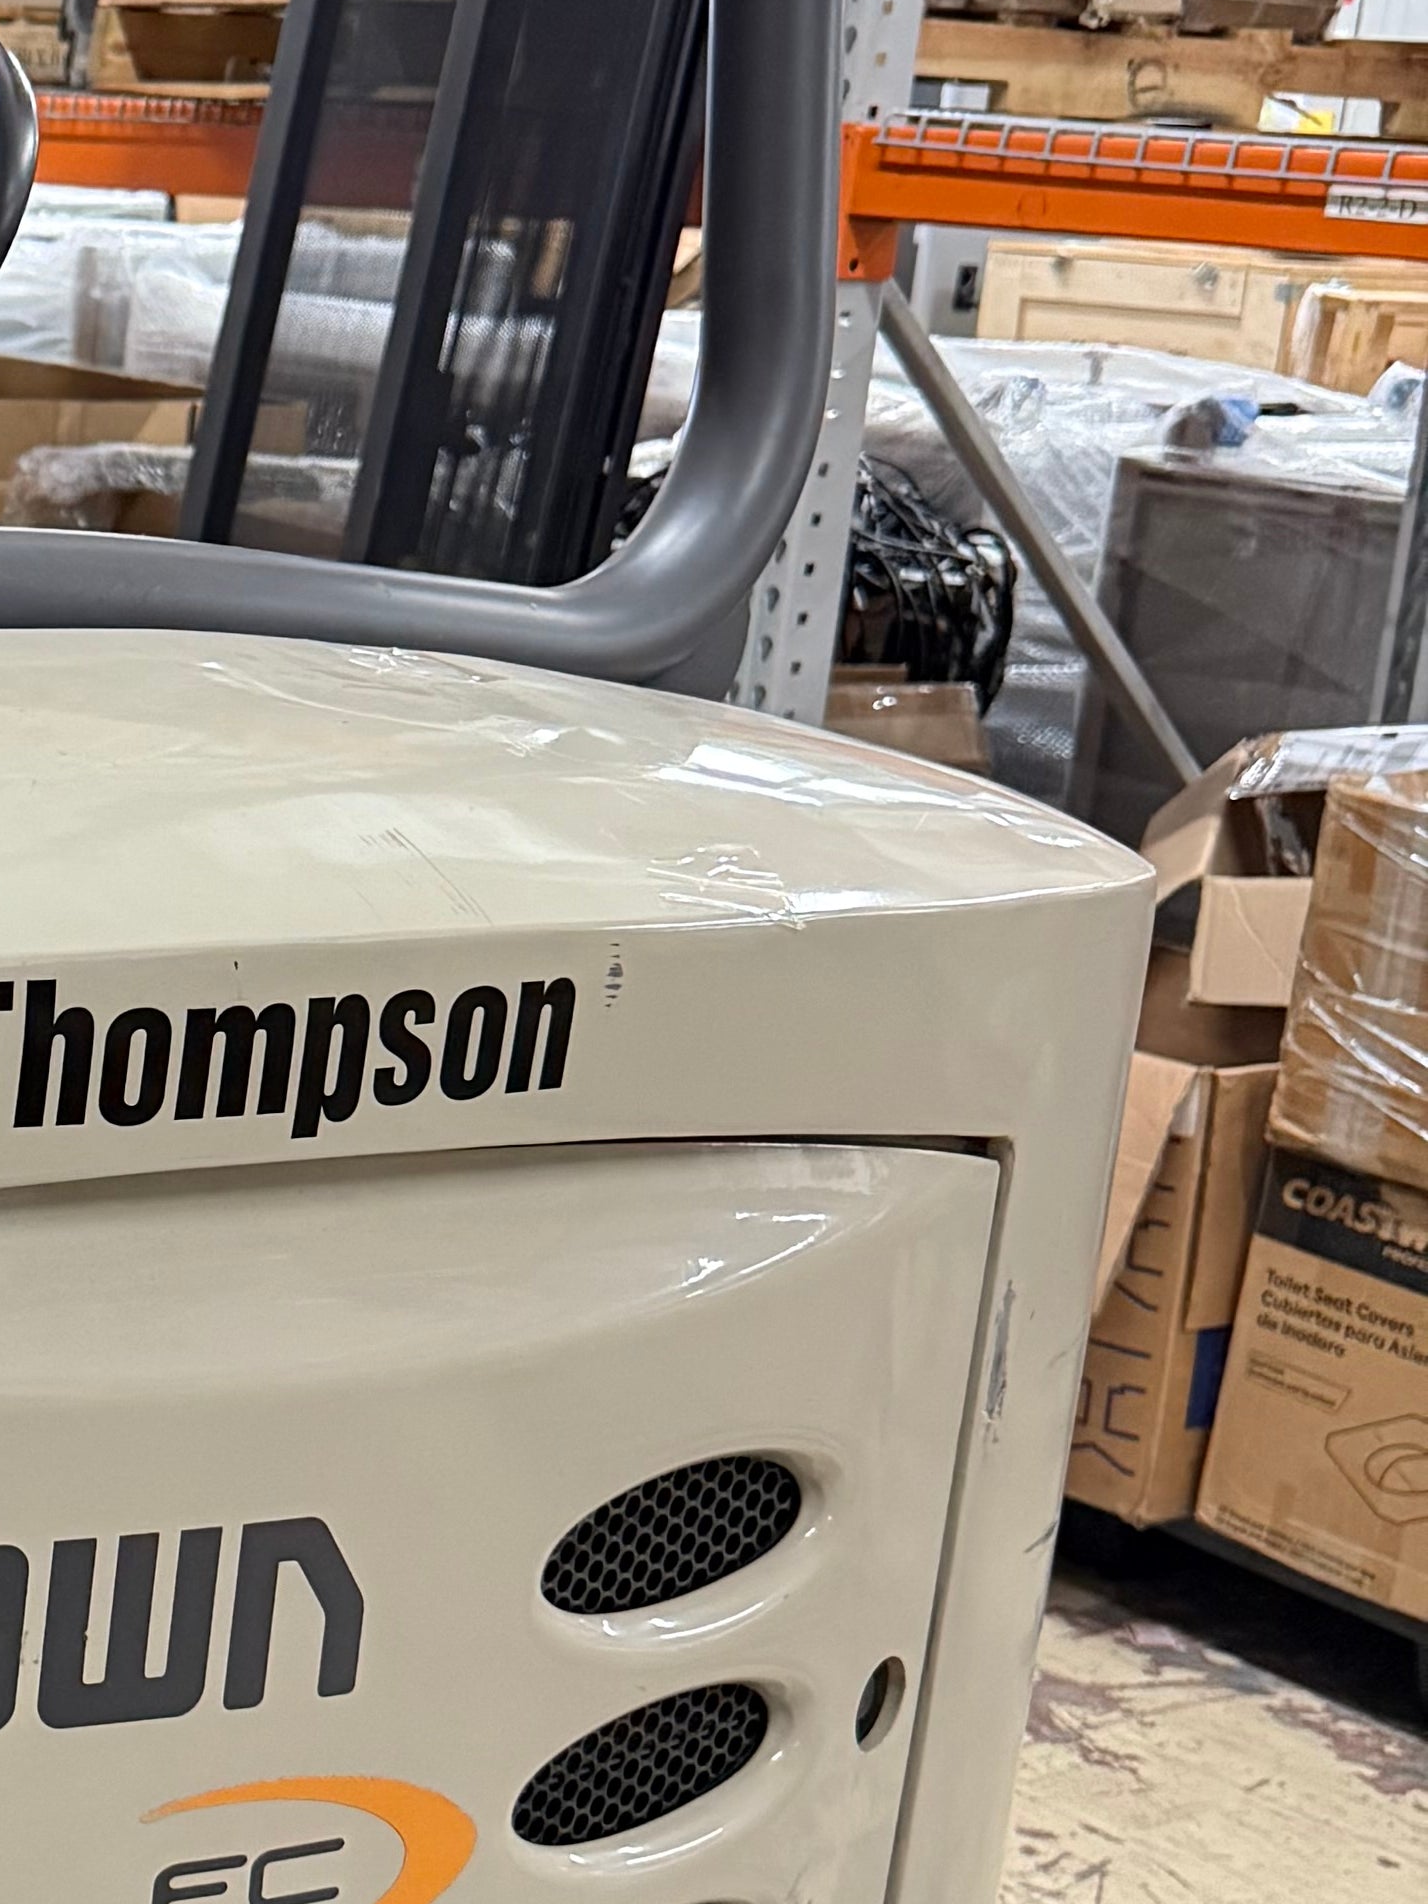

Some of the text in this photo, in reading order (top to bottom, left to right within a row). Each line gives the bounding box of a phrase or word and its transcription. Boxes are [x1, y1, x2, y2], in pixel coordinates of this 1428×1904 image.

[1267, 1268, 1415, 1338] Toilet Seat Covers
